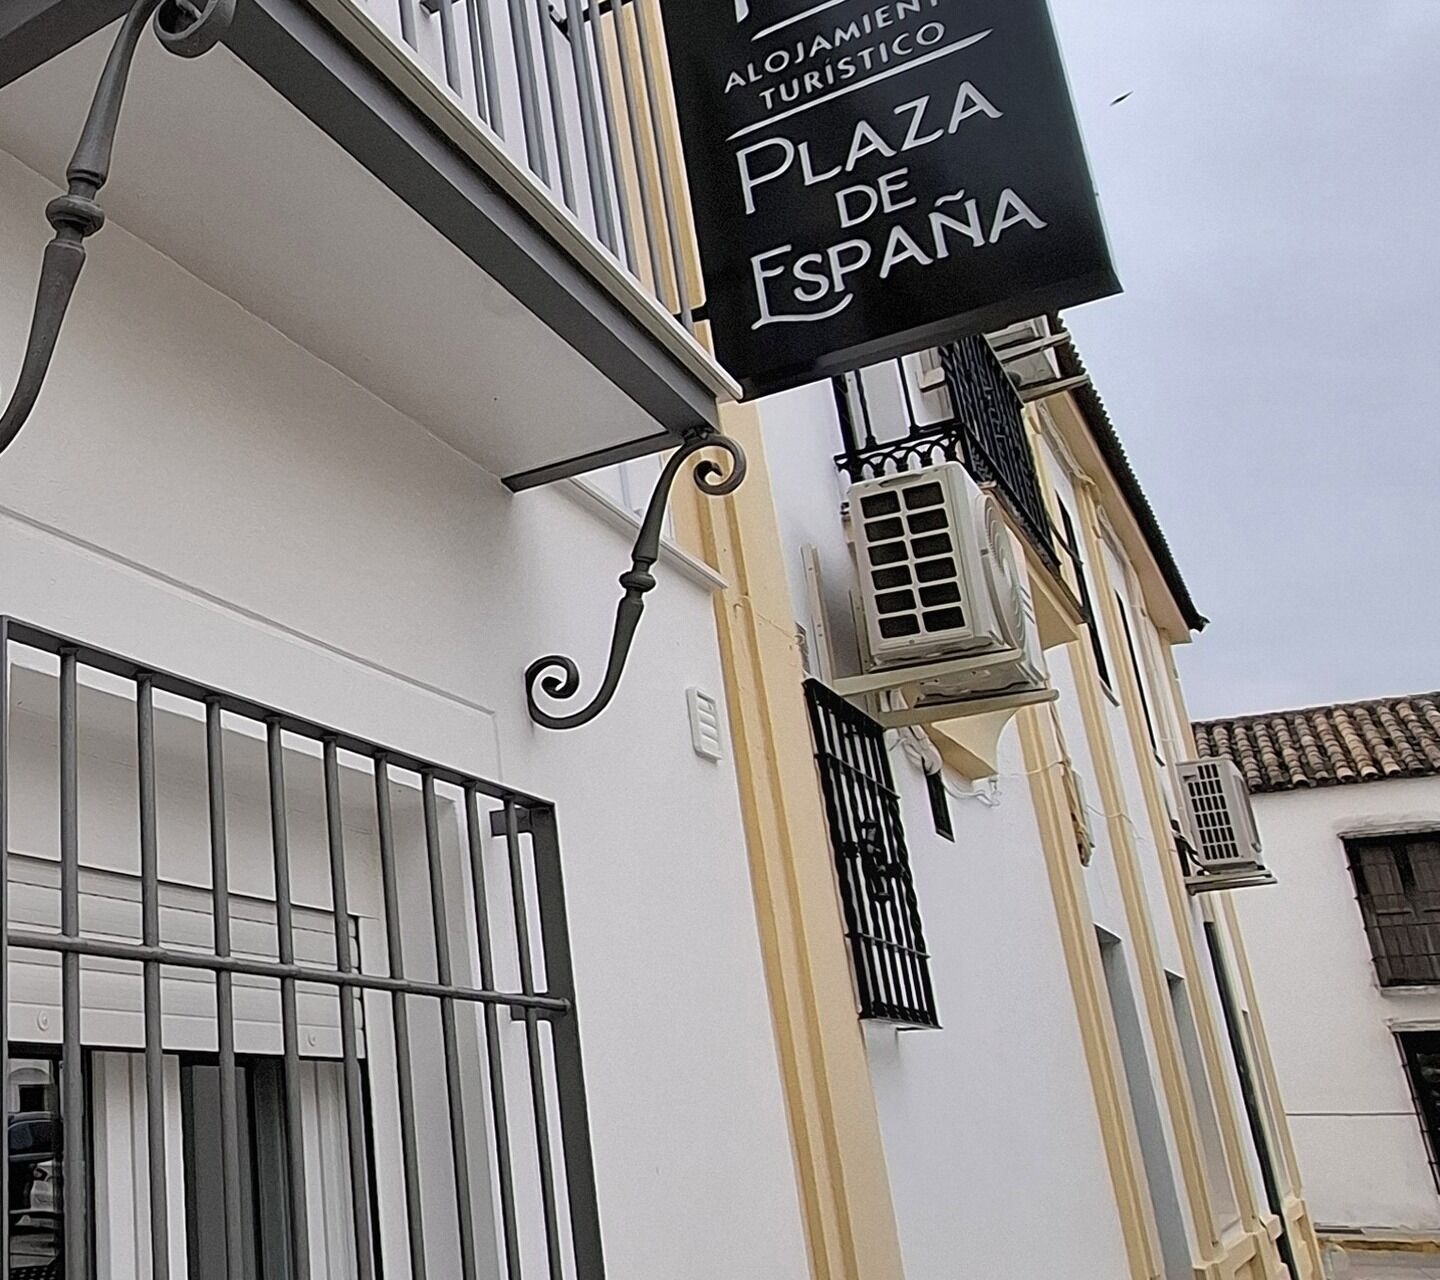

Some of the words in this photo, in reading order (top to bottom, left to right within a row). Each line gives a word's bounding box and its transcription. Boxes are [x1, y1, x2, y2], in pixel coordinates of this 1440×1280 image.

[758, 21, 946, 111] TURÍSTICO
[732, 79, 1005, 216] PLAZA
[835, 167, 918, 229] DE
[749, 186, 1049, 331] ESPAÑA
